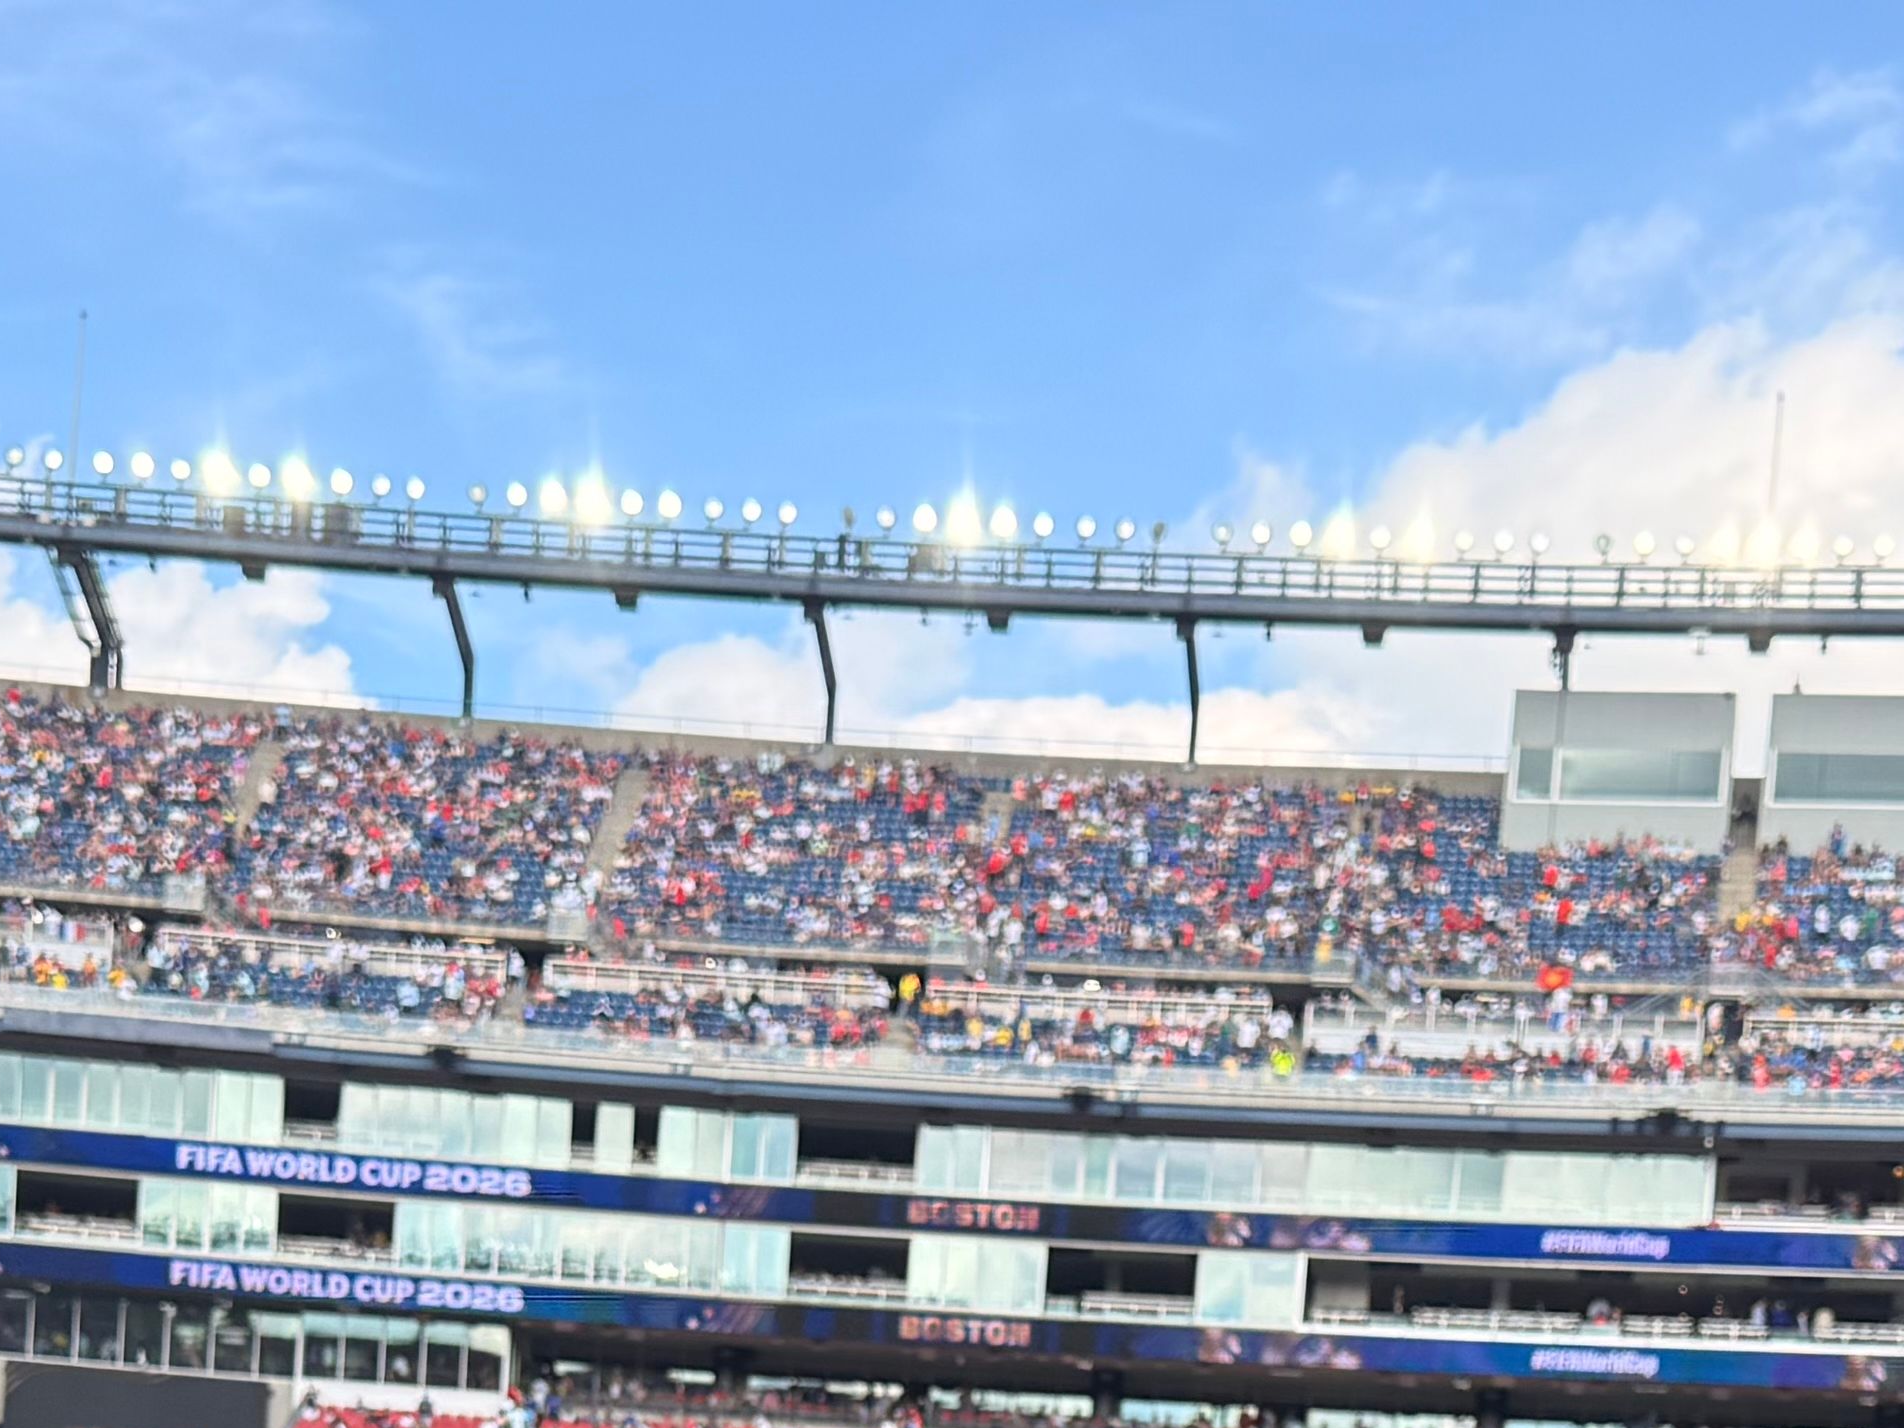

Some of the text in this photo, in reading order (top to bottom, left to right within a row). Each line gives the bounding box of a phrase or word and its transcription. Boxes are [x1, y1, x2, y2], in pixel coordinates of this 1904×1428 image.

[176, 1143, 532, 1198] FIFA WORLD CUP 2026
[907, 1200, 1040, 1230] BOSTON
[169, 1260, 524, 1313] FIFA WORLD CUP 2026
[899, 1316, 1032, 1346] BOSTON
